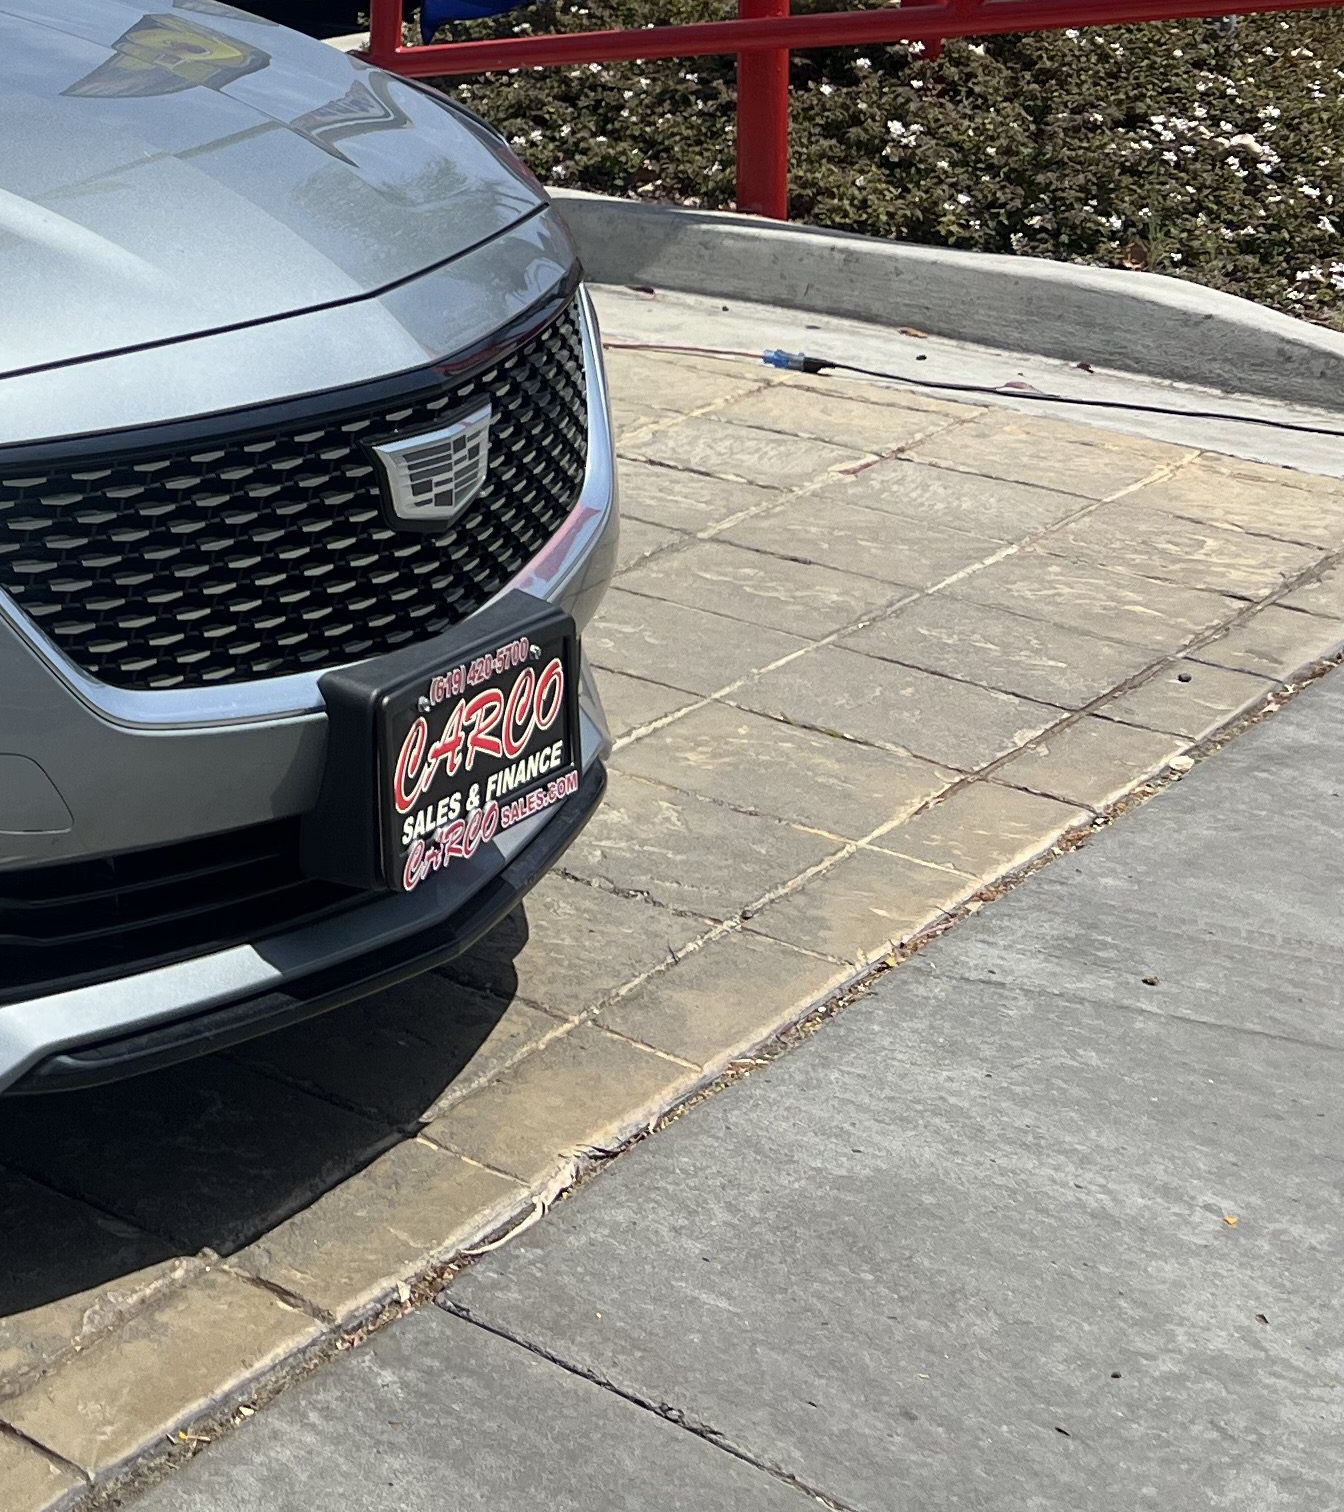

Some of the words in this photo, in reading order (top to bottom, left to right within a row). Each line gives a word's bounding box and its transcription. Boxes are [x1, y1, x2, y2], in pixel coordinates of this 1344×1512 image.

[430, 664, 466, 705] (619)
[394, 657, 564, 814] CARCO
[401, 791, 462, 845] SALES
[465, 783, 480, 811] &
[485, 739, 563, 802] FINANCE
[403, 800, 499, 891] CARCO
